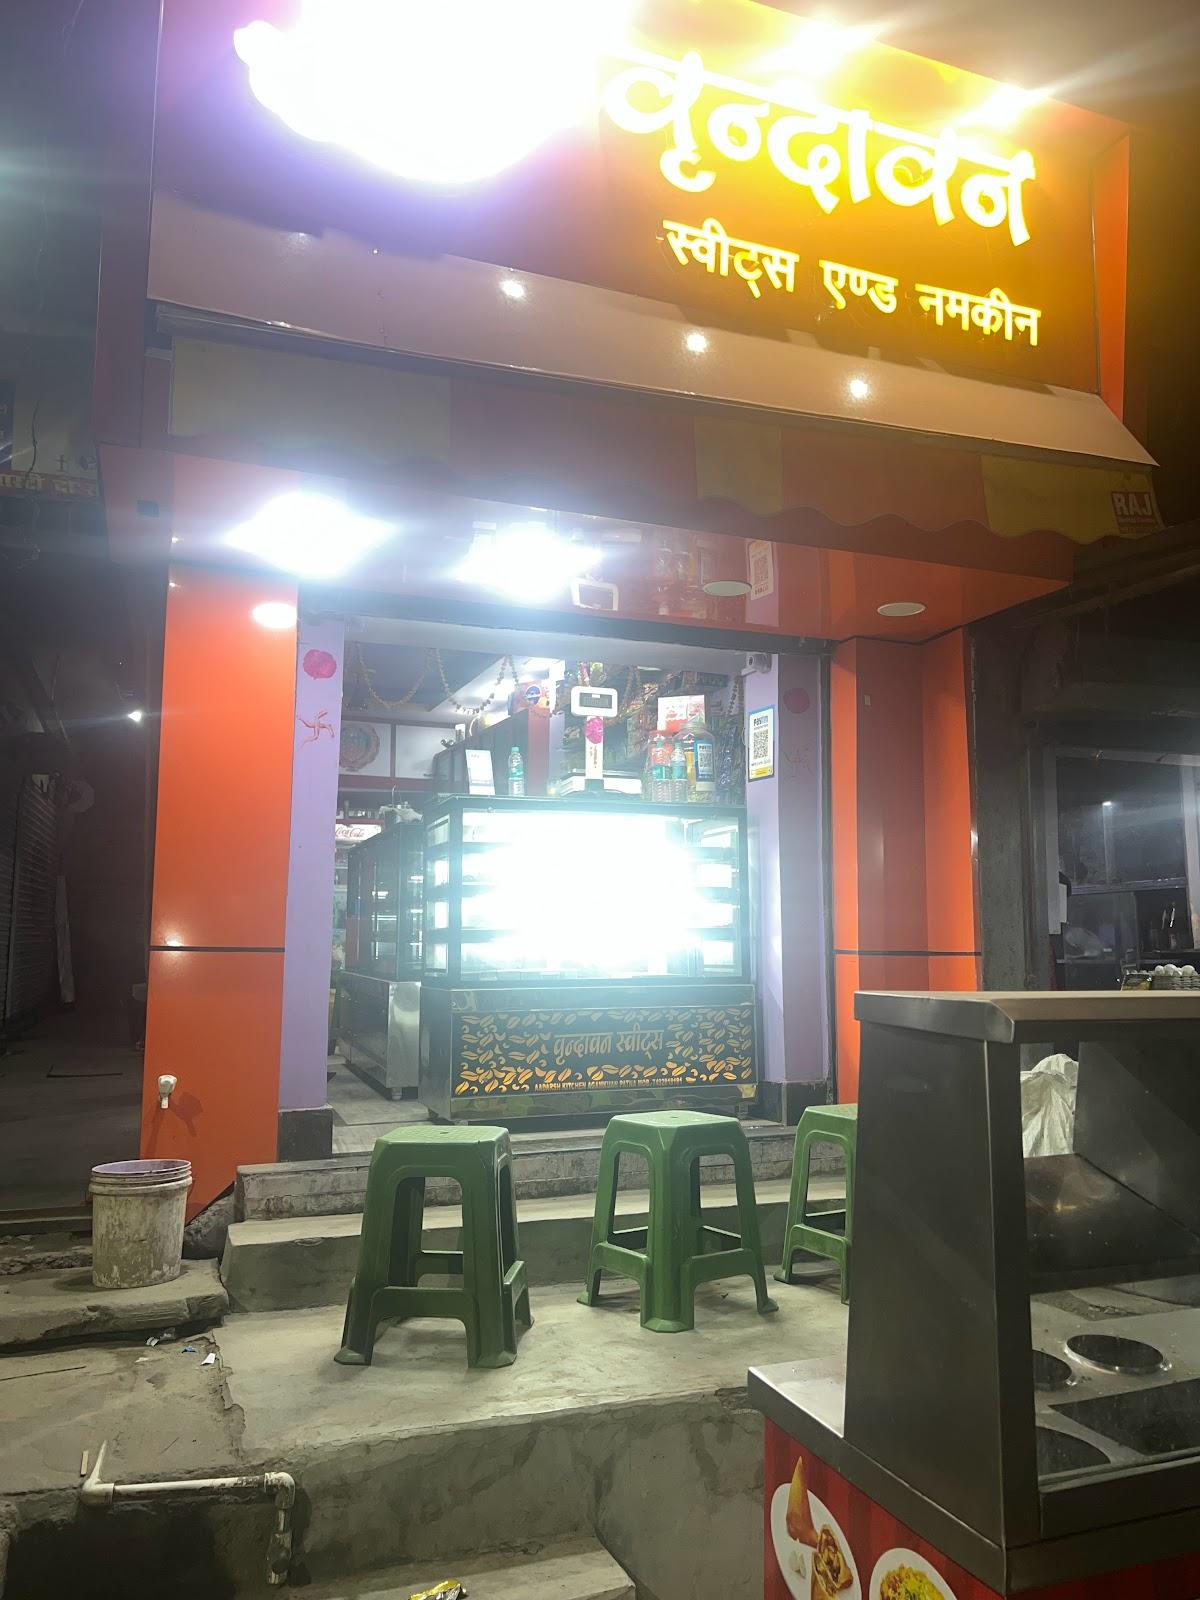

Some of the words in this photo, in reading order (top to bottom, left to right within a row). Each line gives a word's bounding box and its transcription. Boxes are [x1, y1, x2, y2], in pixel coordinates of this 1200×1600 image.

[602, 50, 1037, 247] वृन्दावन
[662, 217, 799, 299] स्वीट्स
[818, 259, 899, 314] एण्ड
[914, 286, 1042, 346] नमकीन
[1112, 493, 1152, 515] RAJ
[616, 1022, 665, 1060] स्वीट्स
[534, 1082, 561, 1092] AADARSH
[562, 1081, 587, 1091] KITCHEN
